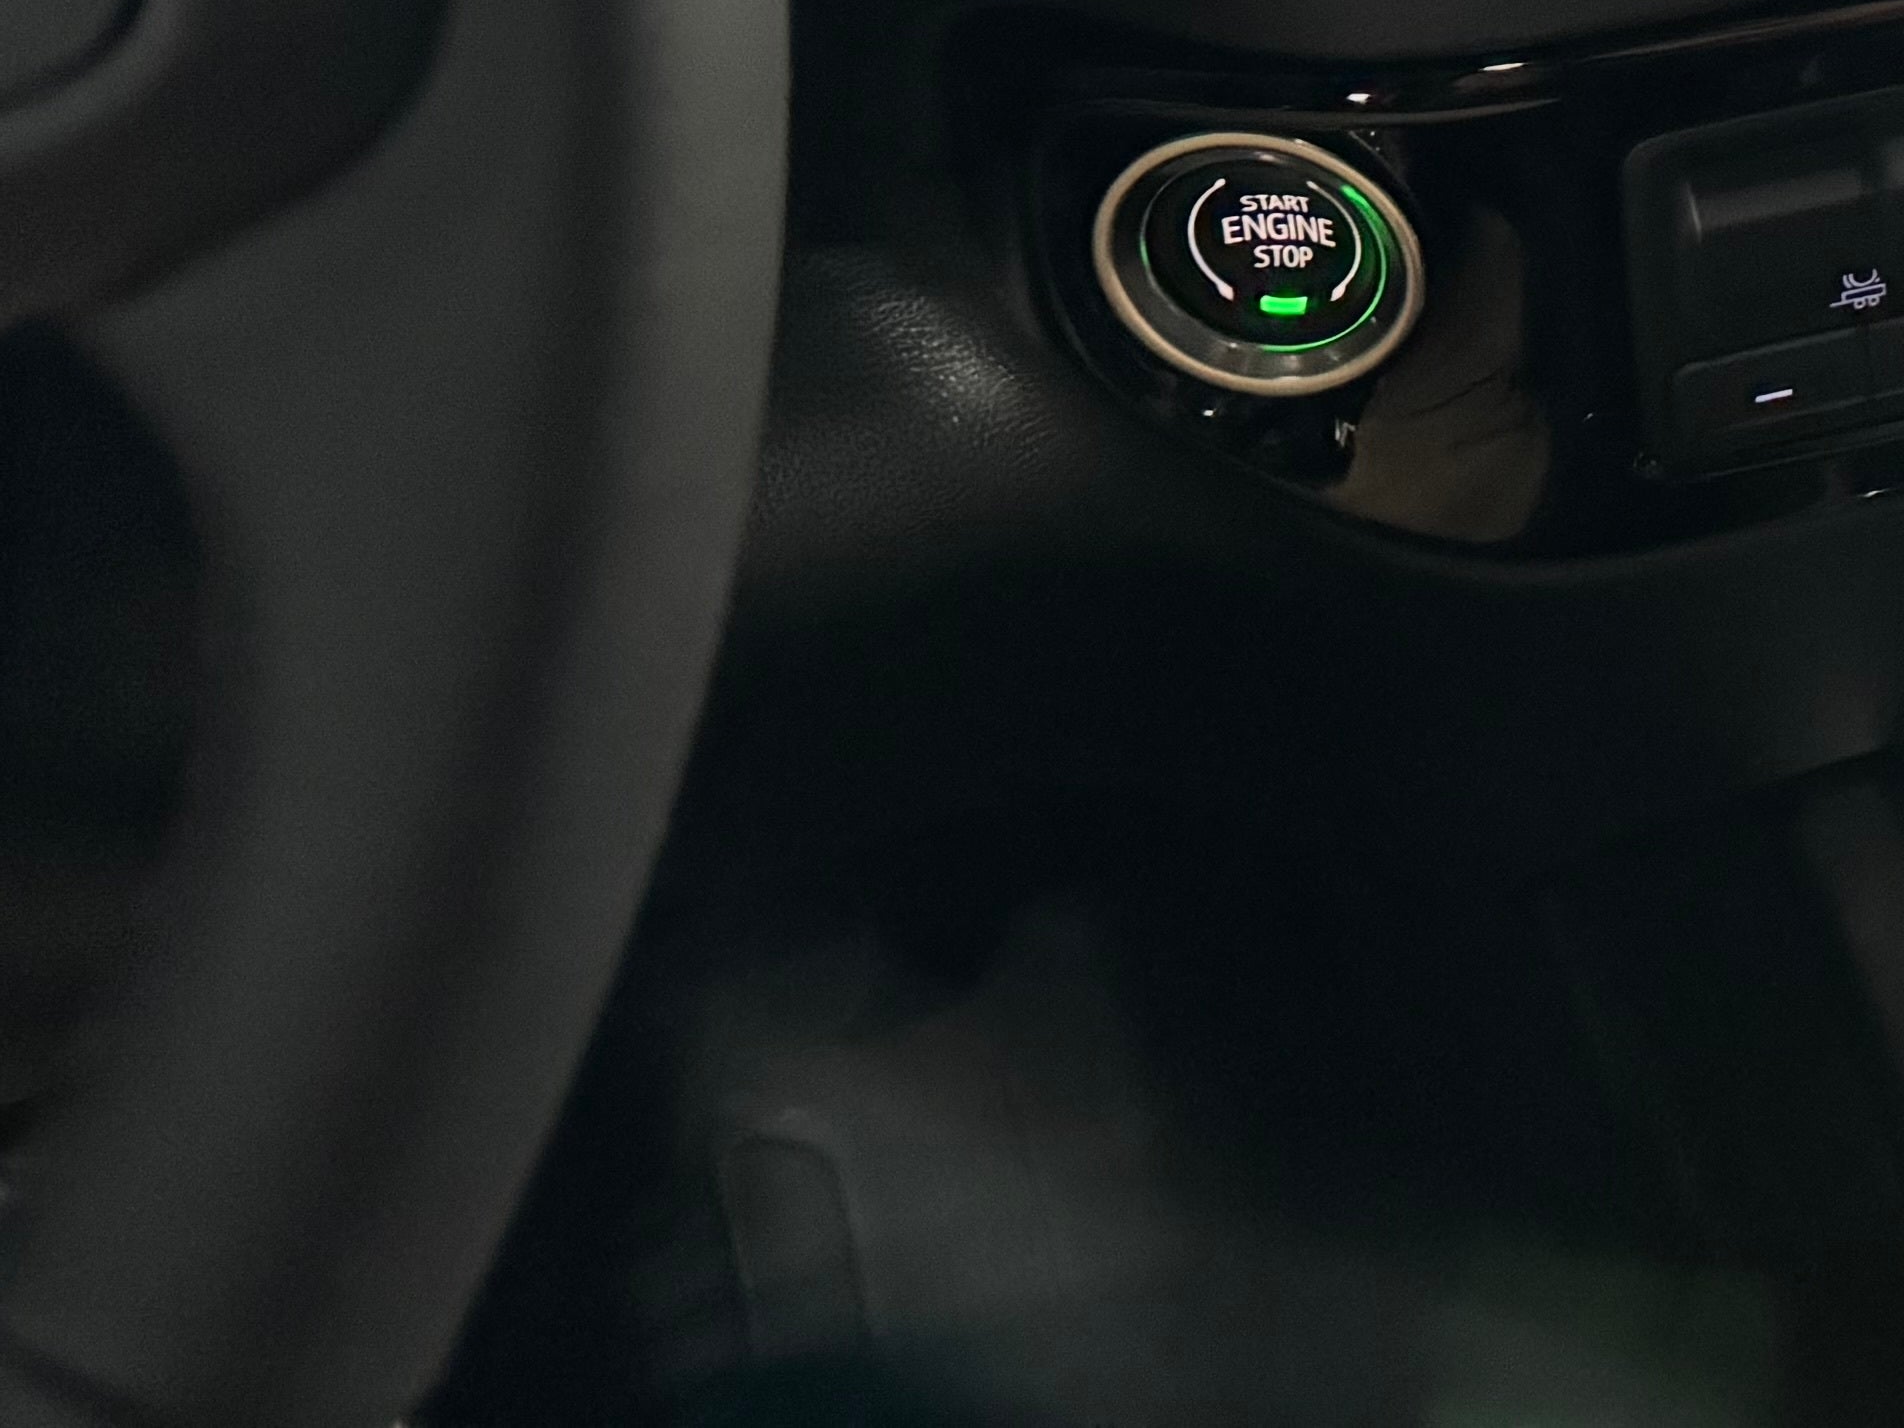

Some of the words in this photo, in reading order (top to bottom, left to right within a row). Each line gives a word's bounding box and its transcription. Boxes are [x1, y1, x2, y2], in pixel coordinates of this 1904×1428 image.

[1240, 194, 1309, 213] START
[1221, 212, 1336, 248] ENGINE
[1253, 244, 1314, 268] STOP
